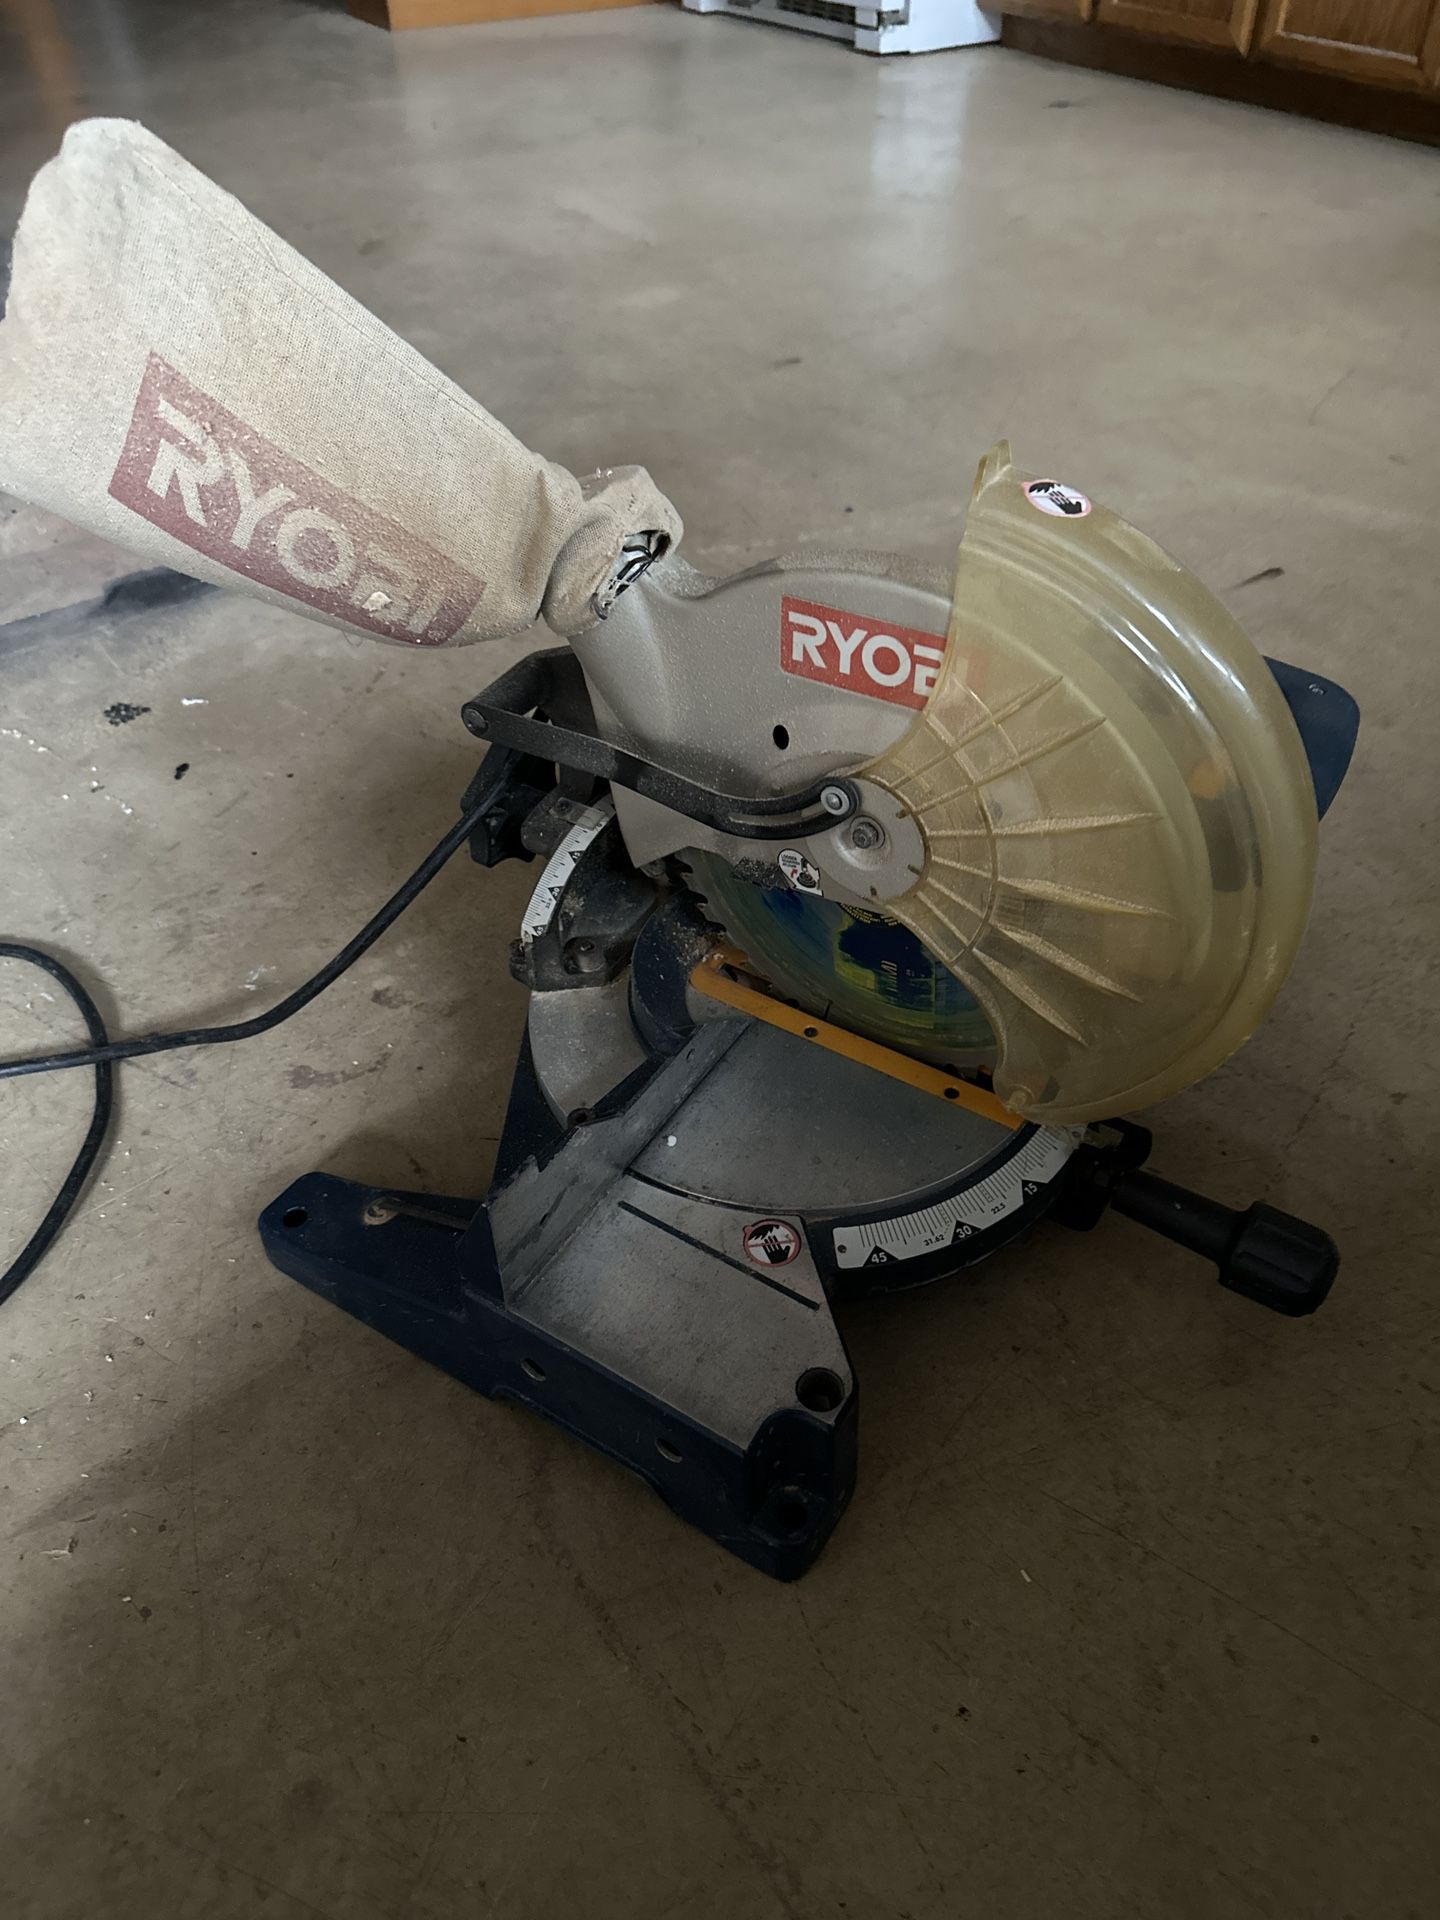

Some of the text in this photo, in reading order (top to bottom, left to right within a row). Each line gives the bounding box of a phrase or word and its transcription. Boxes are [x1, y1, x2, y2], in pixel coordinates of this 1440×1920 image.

[147, 399, 443, 634] RYOBI
[1024, 1182, 1038, 1196] 15
[991, 1202, 1006, 1215] 22.5
[956, 1225, 972, 1238] 30
[923, 1234, 945, 1247] 31.62
[871, 1252, 888, 1264] 45
